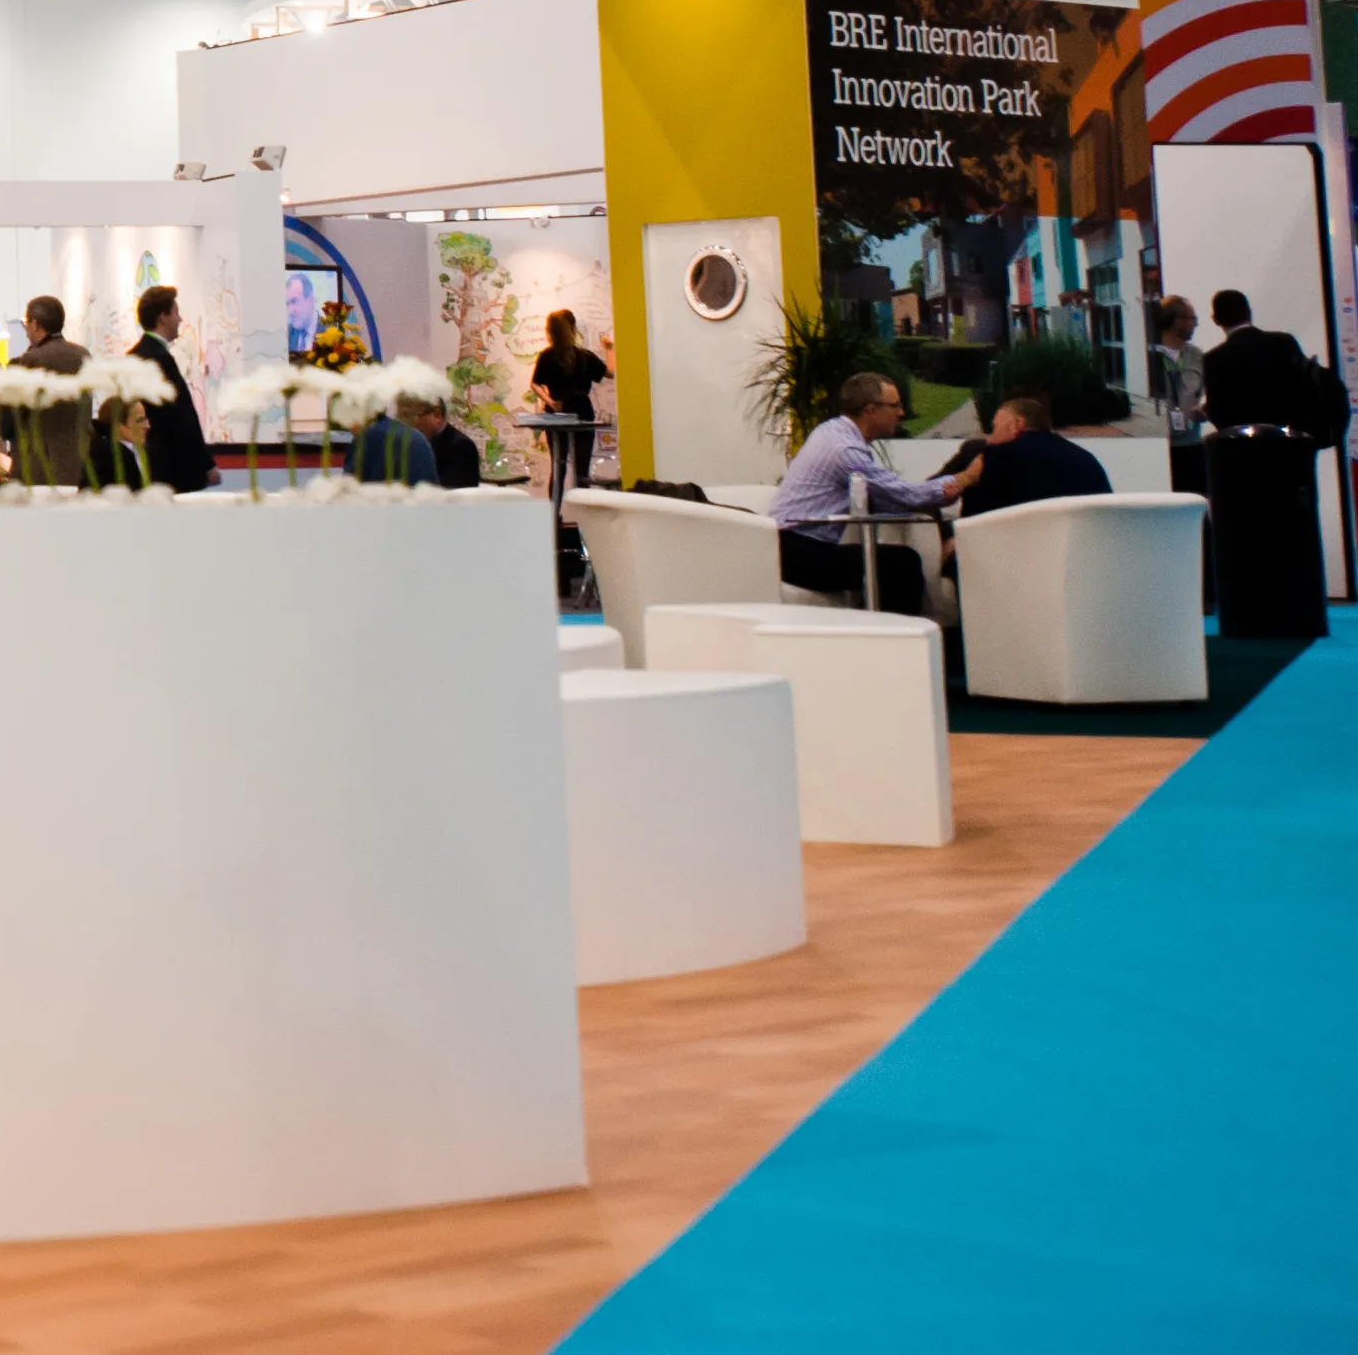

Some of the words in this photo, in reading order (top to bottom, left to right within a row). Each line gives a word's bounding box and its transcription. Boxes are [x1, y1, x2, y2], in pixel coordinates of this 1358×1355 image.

[829, 10, 887, 51] BRE
[894, 16, 1059, 64] International
[832, 68, 975, 115] Innovation
[981, 78, 1042, 118] Park
[836, 126, 953, 168] Network
